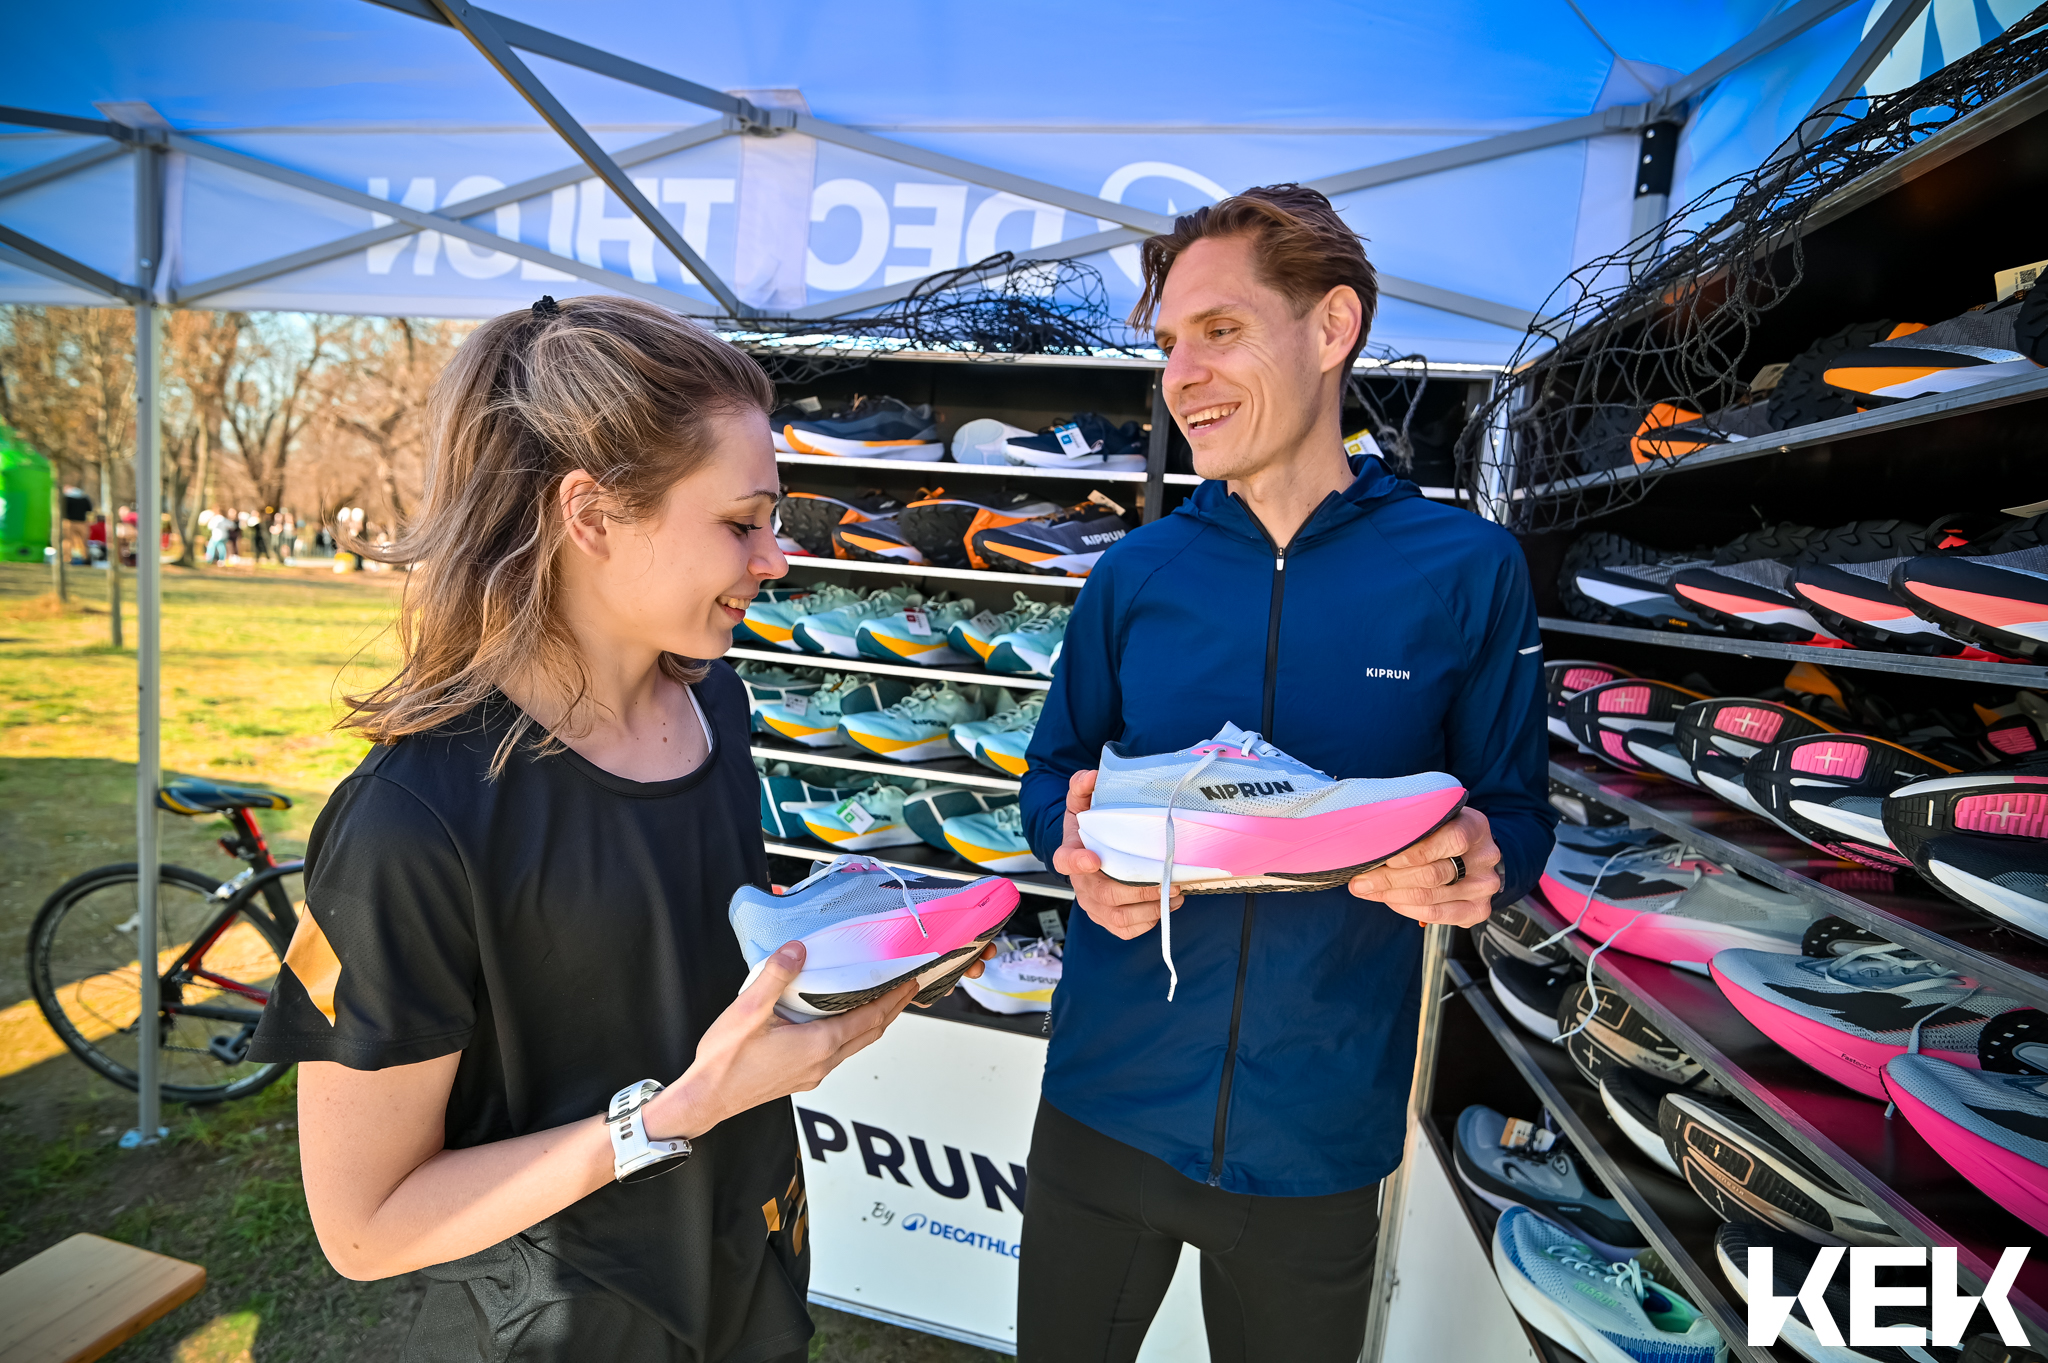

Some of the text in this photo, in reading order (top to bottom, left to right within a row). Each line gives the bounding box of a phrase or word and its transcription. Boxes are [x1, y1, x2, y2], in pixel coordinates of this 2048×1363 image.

[1366, 667, 1410, 680] KIPRUN
[1199, 781, 1295, 801] KIPRUN
[870, 1202, 896, 1226] By
[1573, 1281, 1619, 1308] KIPRUN
